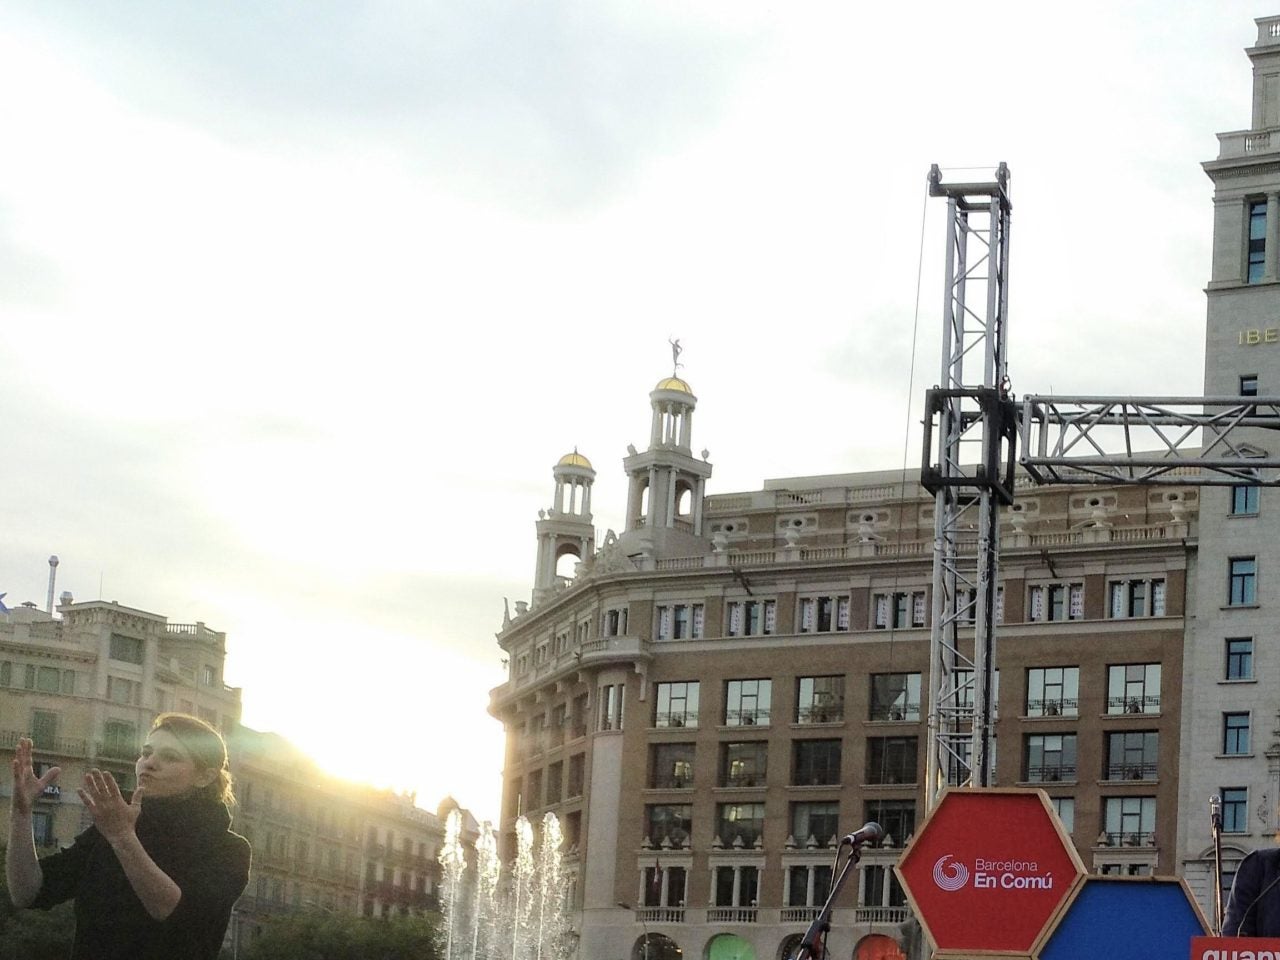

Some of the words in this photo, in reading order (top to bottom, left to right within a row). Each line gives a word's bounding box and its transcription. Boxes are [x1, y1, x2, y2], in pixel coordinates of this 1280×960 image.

[975, 858, 1038, 872] Barcelona
[975, 872, 997, 889] En
[1001, 870, 1053, 889] Comú
